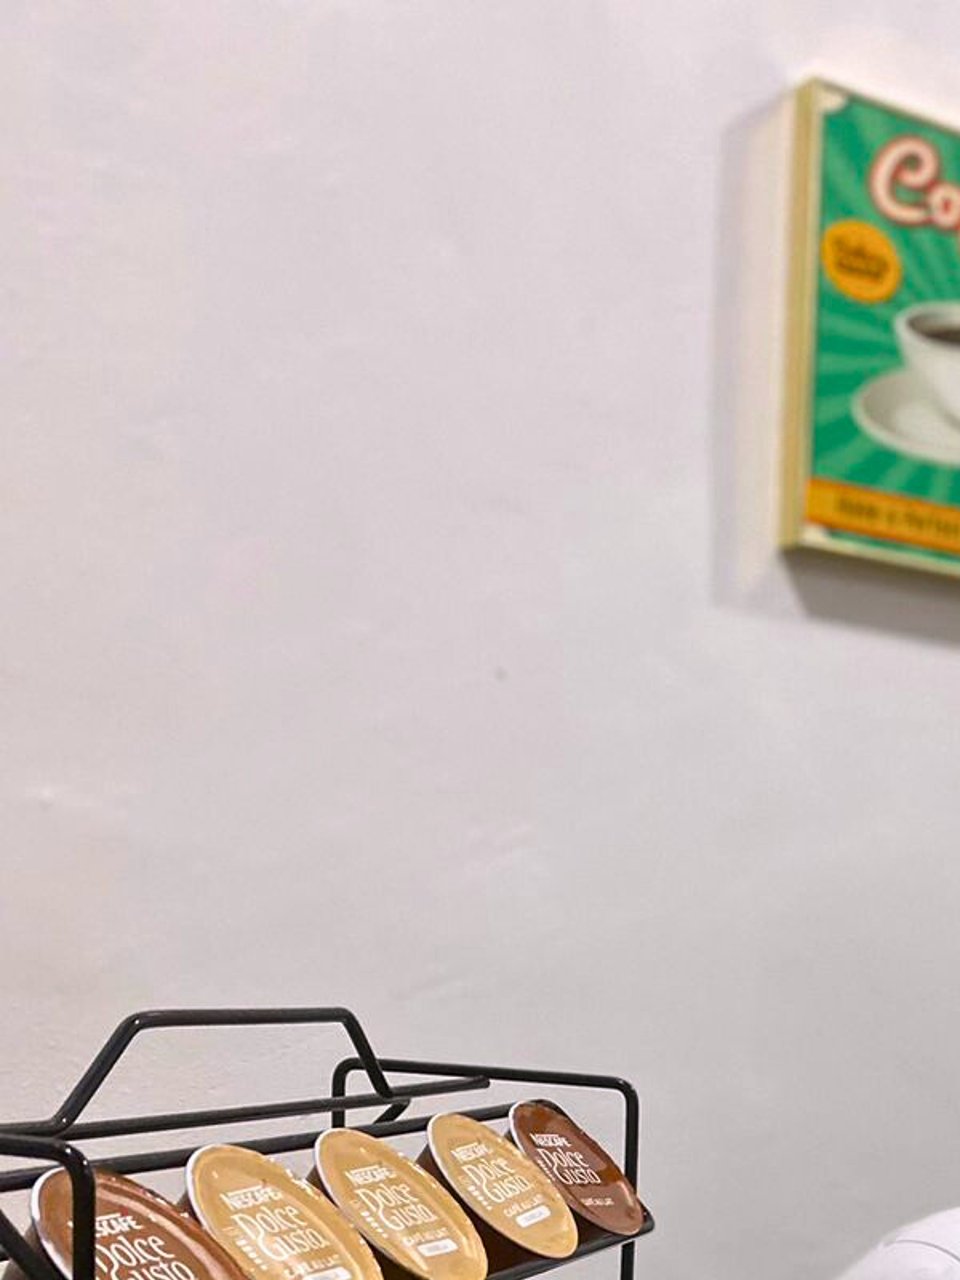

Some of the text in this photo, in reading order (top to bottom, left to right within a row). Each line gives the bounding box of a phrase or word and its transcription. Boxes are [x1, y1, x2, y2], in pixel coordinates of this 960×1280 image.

[461, 1158, 515, 1185] Dolce
[537, 1148, 589, 1168] Dolce
[483, 1176, 532, 1203] Gusto
[553, 1168, 601, 1185] Gusto
[354, 1183, 419, 1212] Dolce
[231, 1205, 308, 1239] Dolce
[379, 1204, 437, 1230] Gusto
[257, 1229, 328, 1261] Gusto
